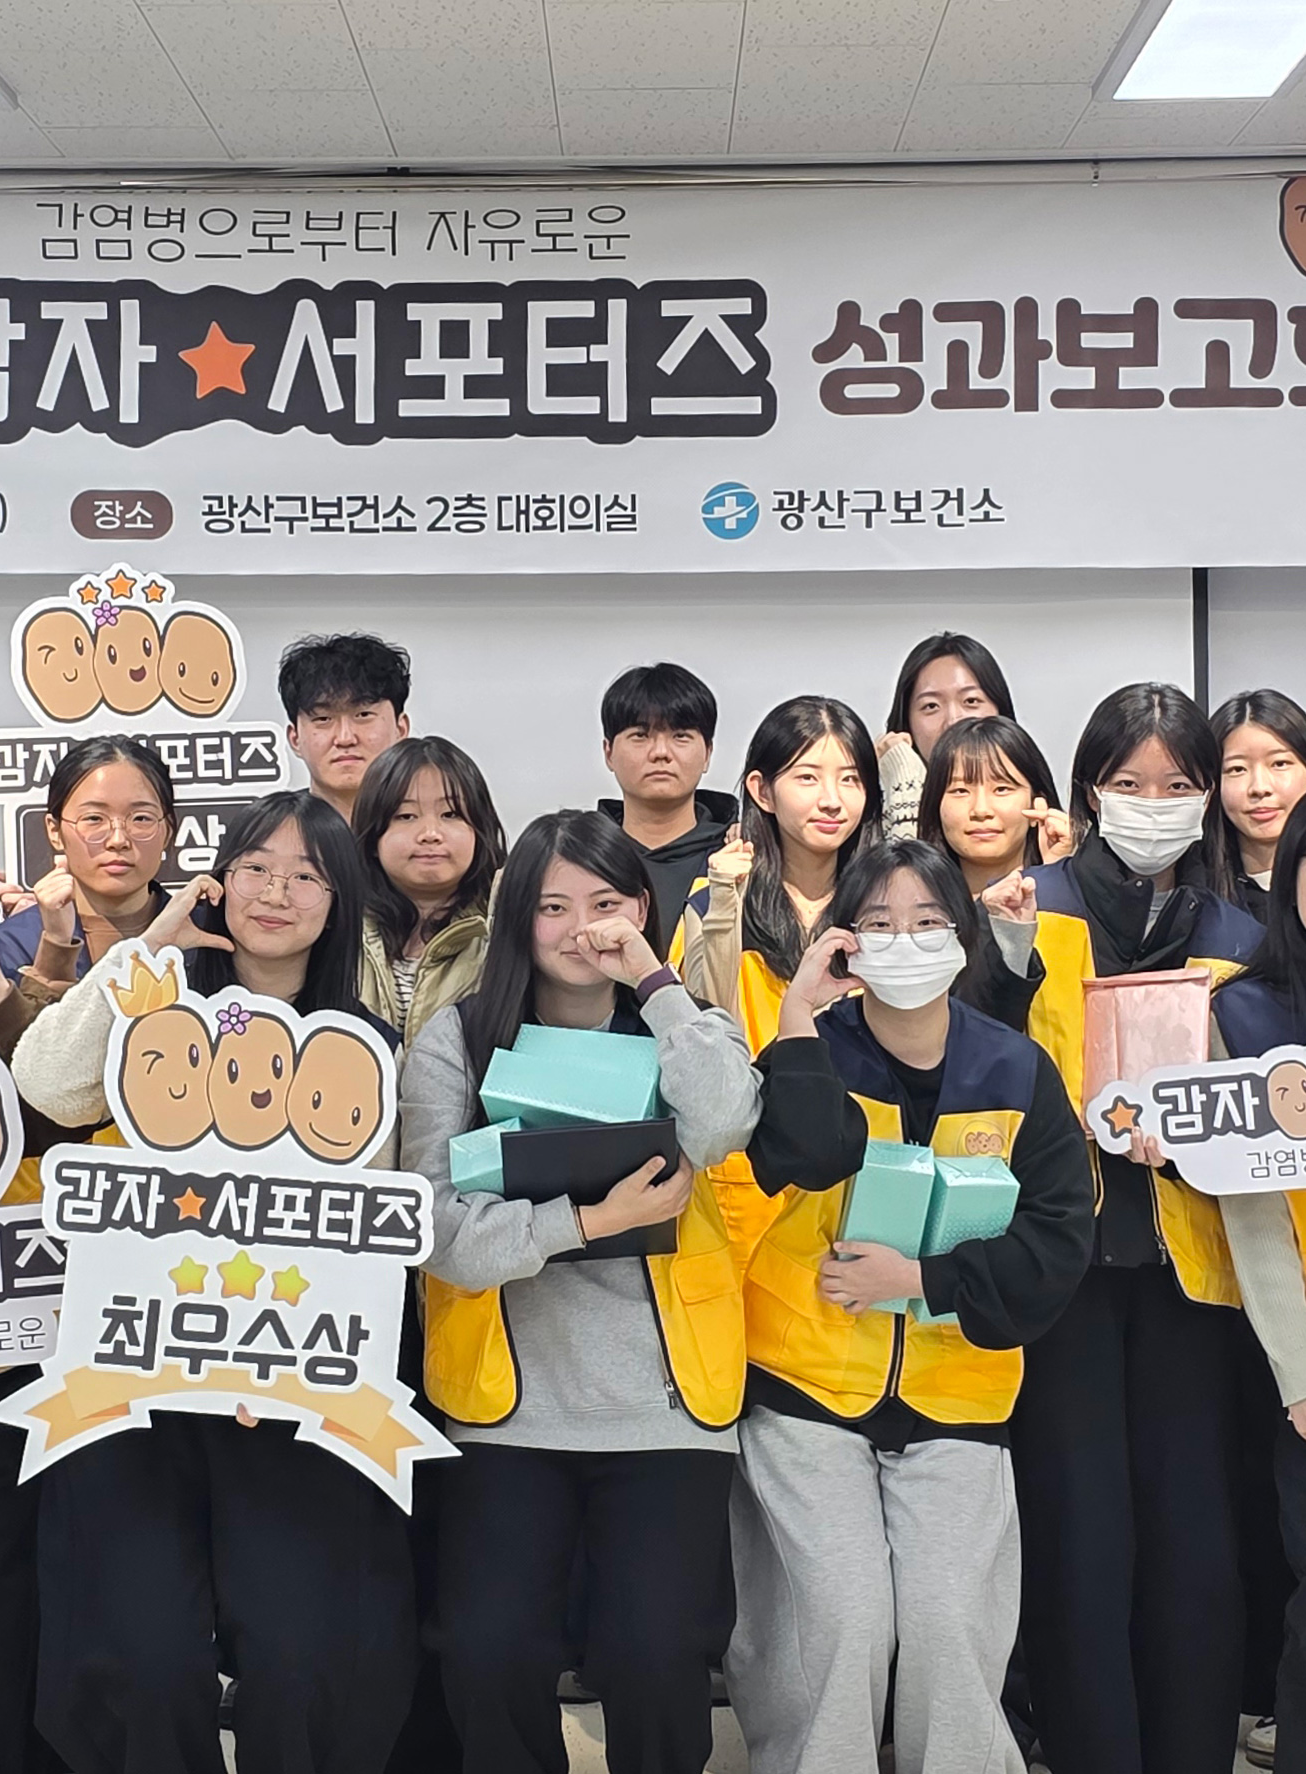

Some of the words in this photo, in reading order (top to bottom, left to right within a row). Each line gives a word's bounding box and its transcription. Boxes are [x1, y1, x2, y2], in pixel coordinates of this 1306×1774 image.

[36, 203, 397, 262] 감염병으로부터
[426, 204, 630, 261] 자유로운
[266, 297, 763, 424] 서포터즈
[91, 500, 155, 530] 장소
[201, 494, 415, 535] 광산구보건소
[425, 495, 488, 534] 2층
[496, 493, 638, 534] 대회의실
[771, 486, 1005, 532] 광산구보건소
[1156, 1079, 1261, 1138] 감자
[61, 1167, 165, 1229] 감자
[207, 1180, 417, 1248] 서포터즈
[94, 1295, 370, 1386] 최우수상
